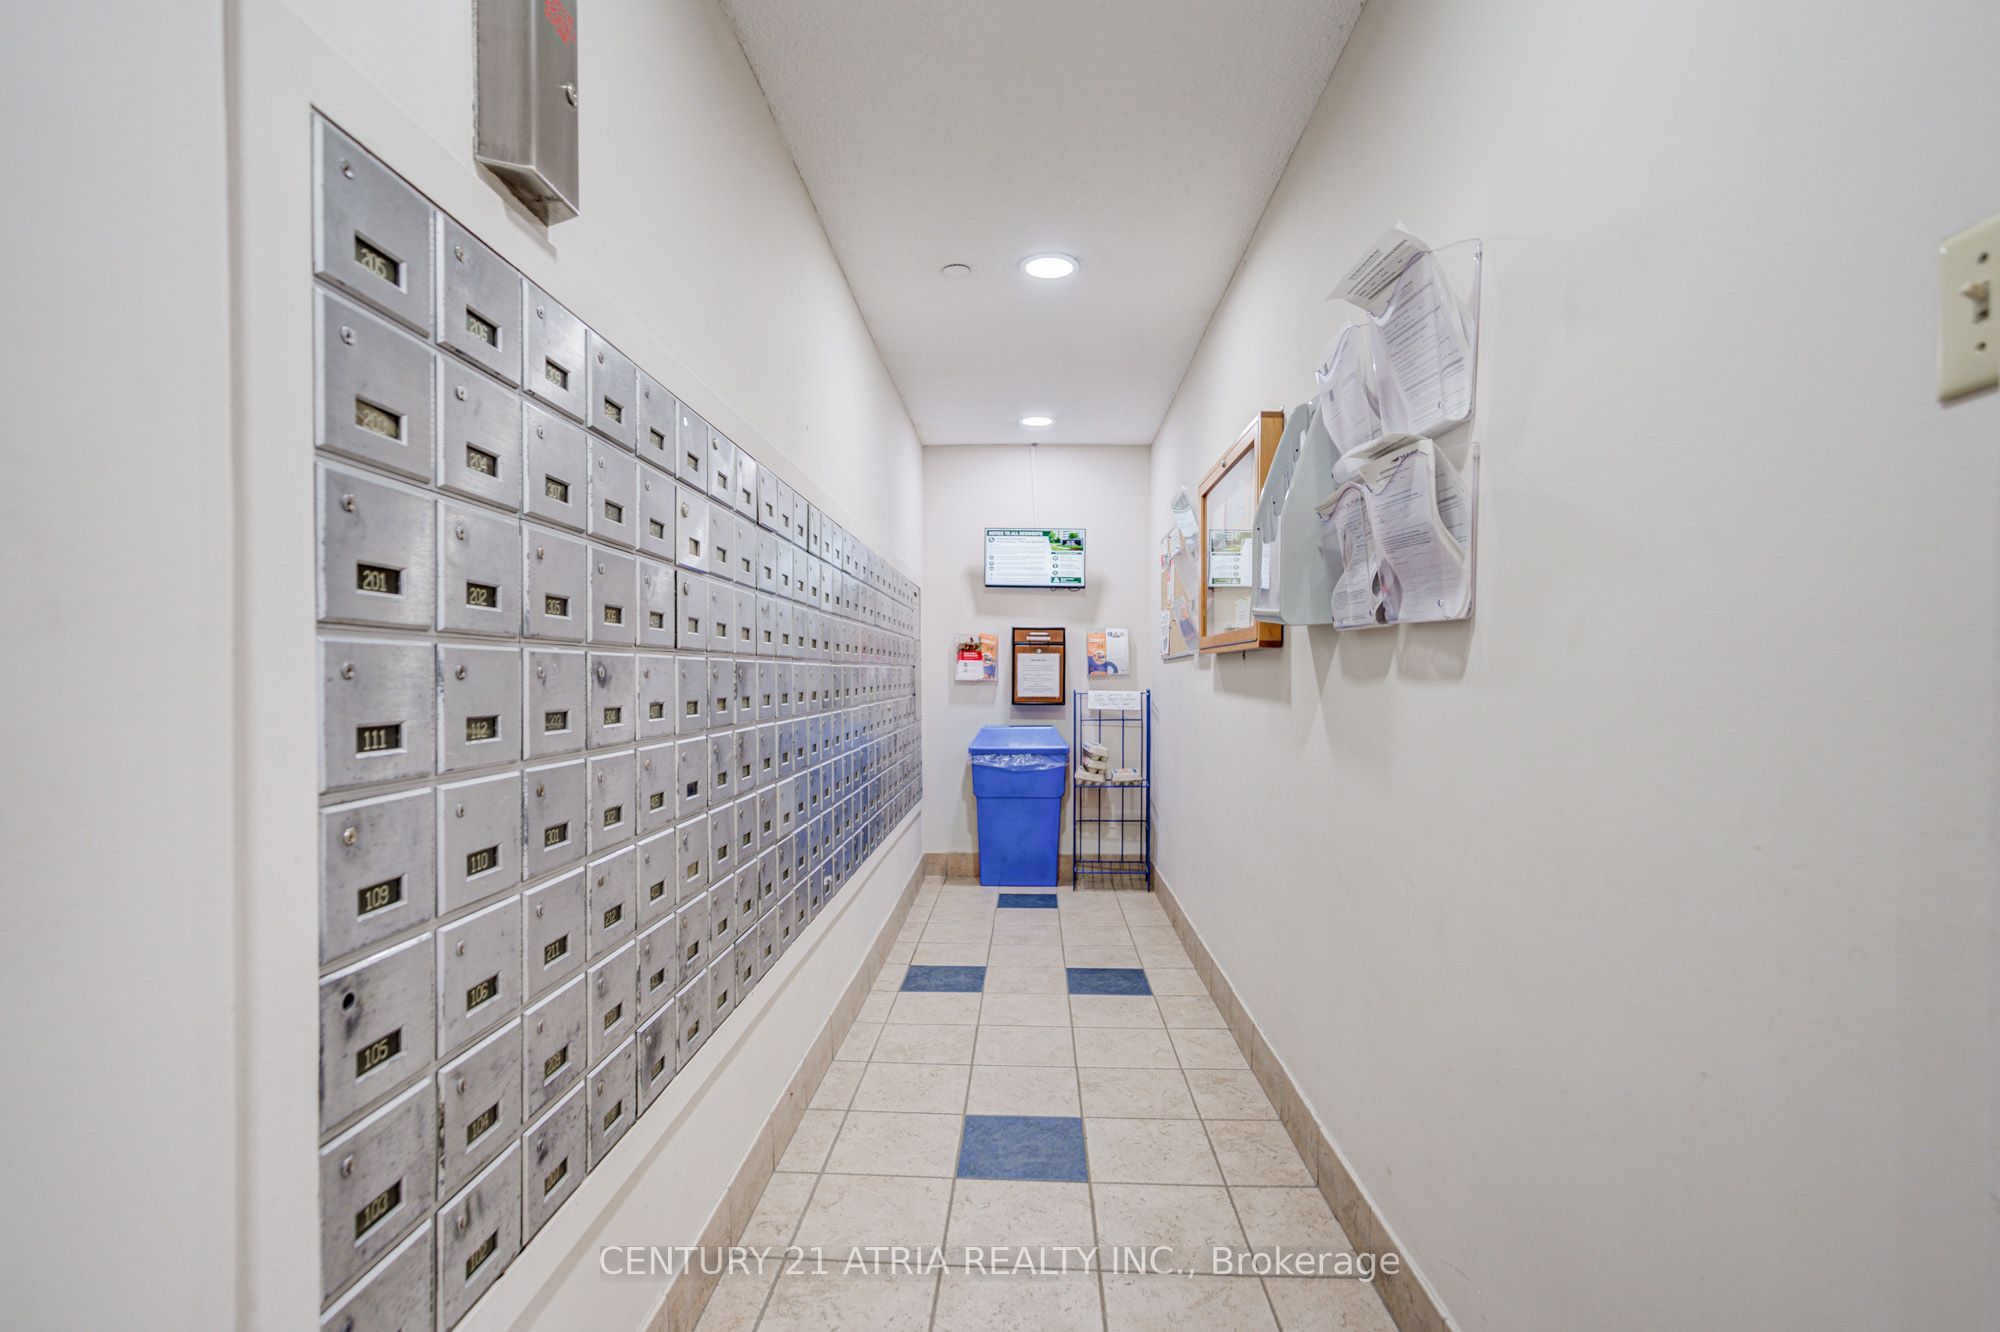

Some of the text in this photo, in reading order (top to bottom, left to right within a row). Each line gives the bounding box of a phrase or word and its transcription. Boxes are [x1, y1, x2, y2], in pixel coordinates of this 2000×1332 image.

[361, 247, 387, 278] 205
[470, 318, 487, 341] 206
[470, 452, 487, 472] 204
[363, 570, 387, 592] 201
[470, 587, 487, 605] 202
[547, 599, 560, 615] 305
[364, 729, 387, 750] 111
[471, 722, 487, 739] 112
[546, 828, 560, 845] 301
[470, 852, 488, 873] 110
[364, 885, 389, 911] 109
[547, 942, 560, 961] 211
[470, 982, 489, 1007] 106
[364, 1038, 389, 1069] 105
[365, 1192, 388, 1226] 103
